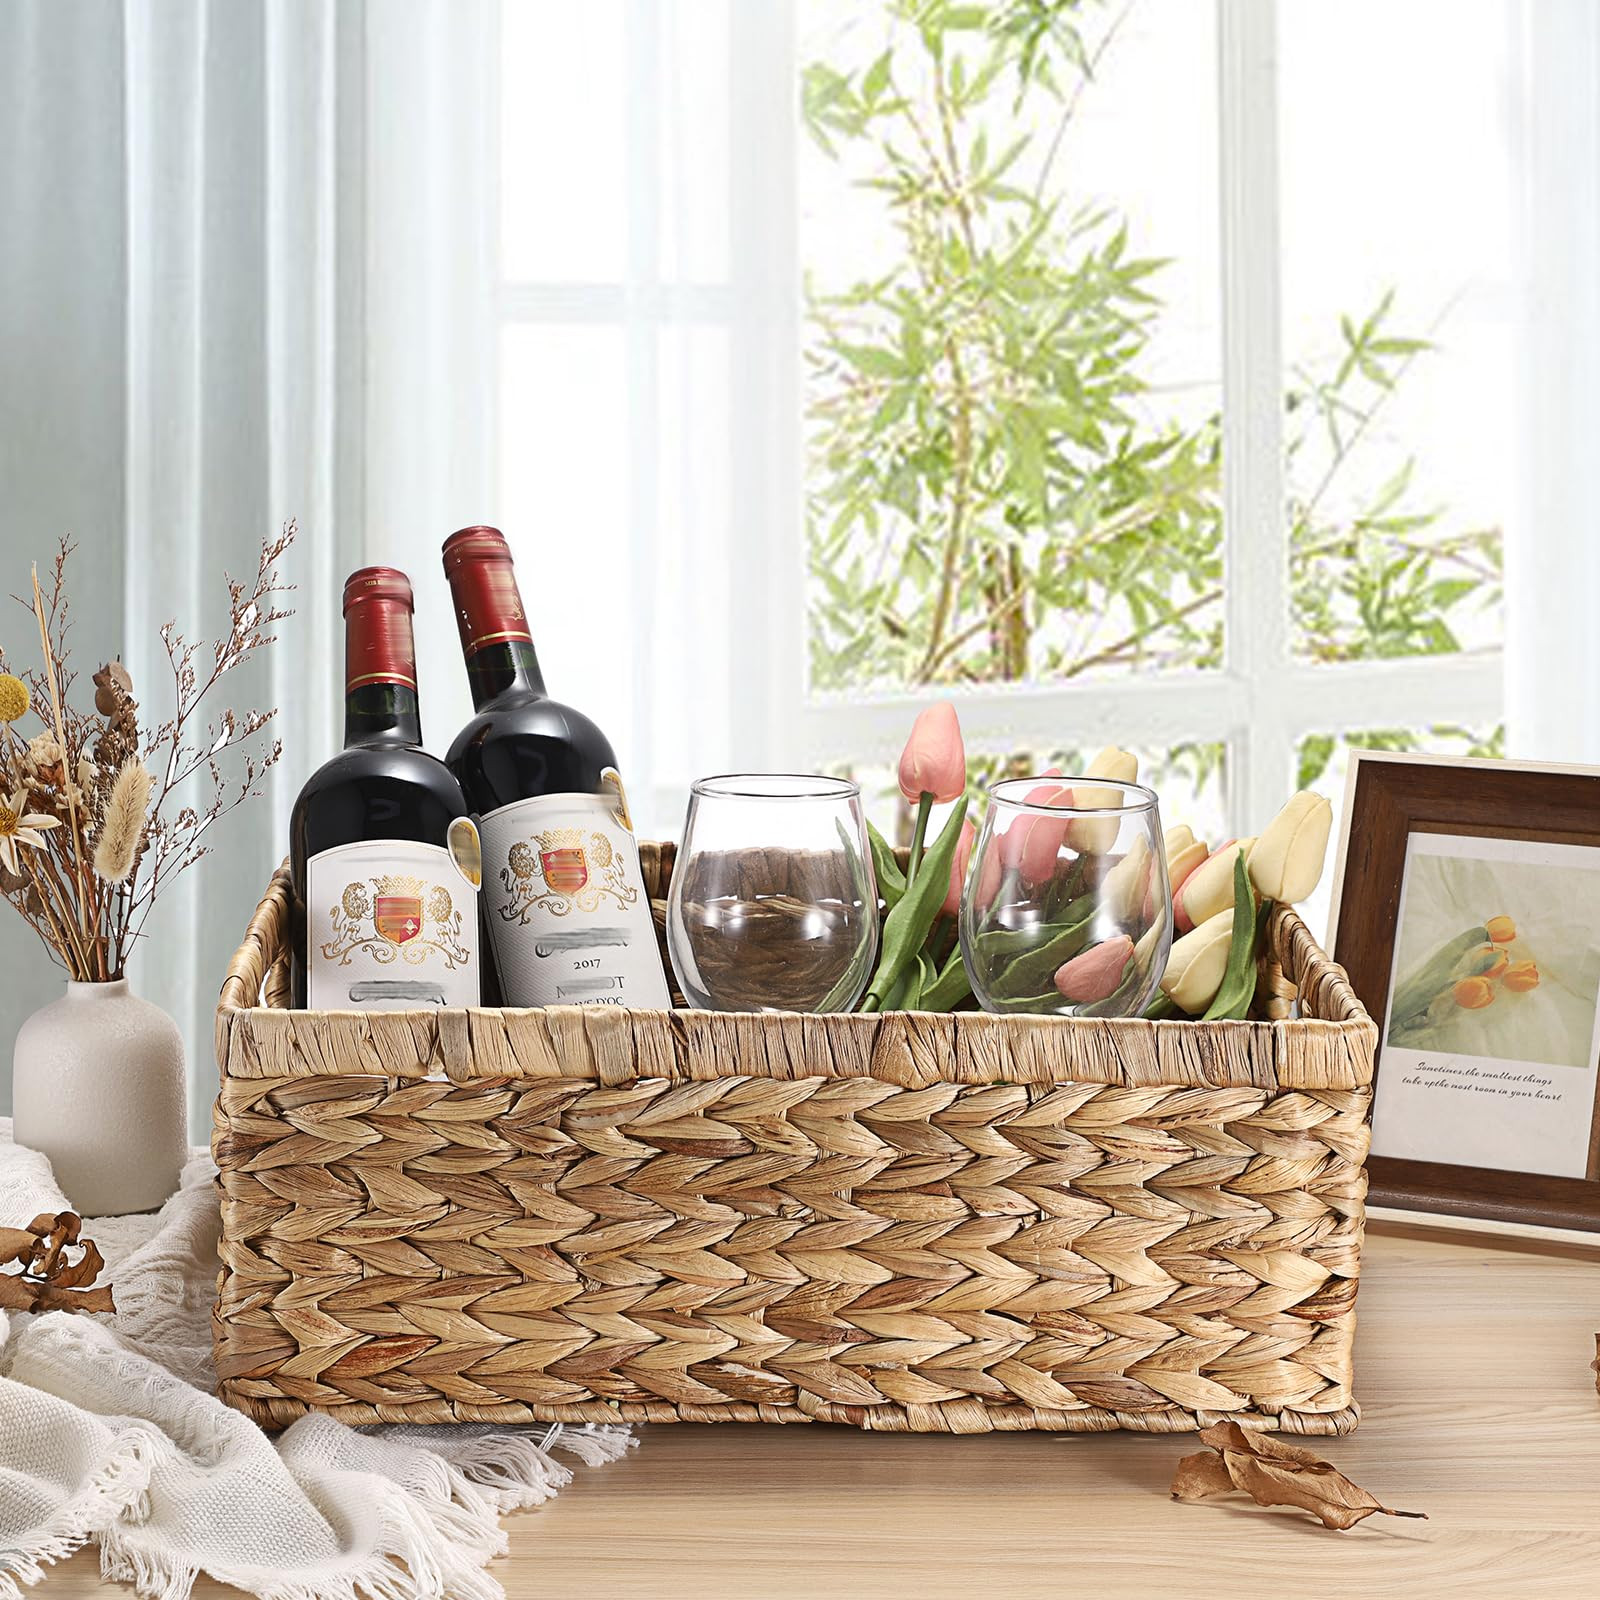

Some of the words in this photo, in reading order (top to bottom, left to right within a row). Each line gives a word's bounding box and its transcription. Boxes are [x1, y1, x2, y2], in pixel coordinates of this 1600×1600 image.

[573, 958, 601, 970] 2017
[1481, 1071, 1522, 1082] smallest
[1522, 1073, 1553, 1086] things
[1401, 1075, 1421, 1085] take
[1474, 1086, 1496, 1094] room
[1498, 1088, 1508, 1096] in
[1510, 1089, 1532, 1099] your
[1534, 1089, 1563, 1101] heart
